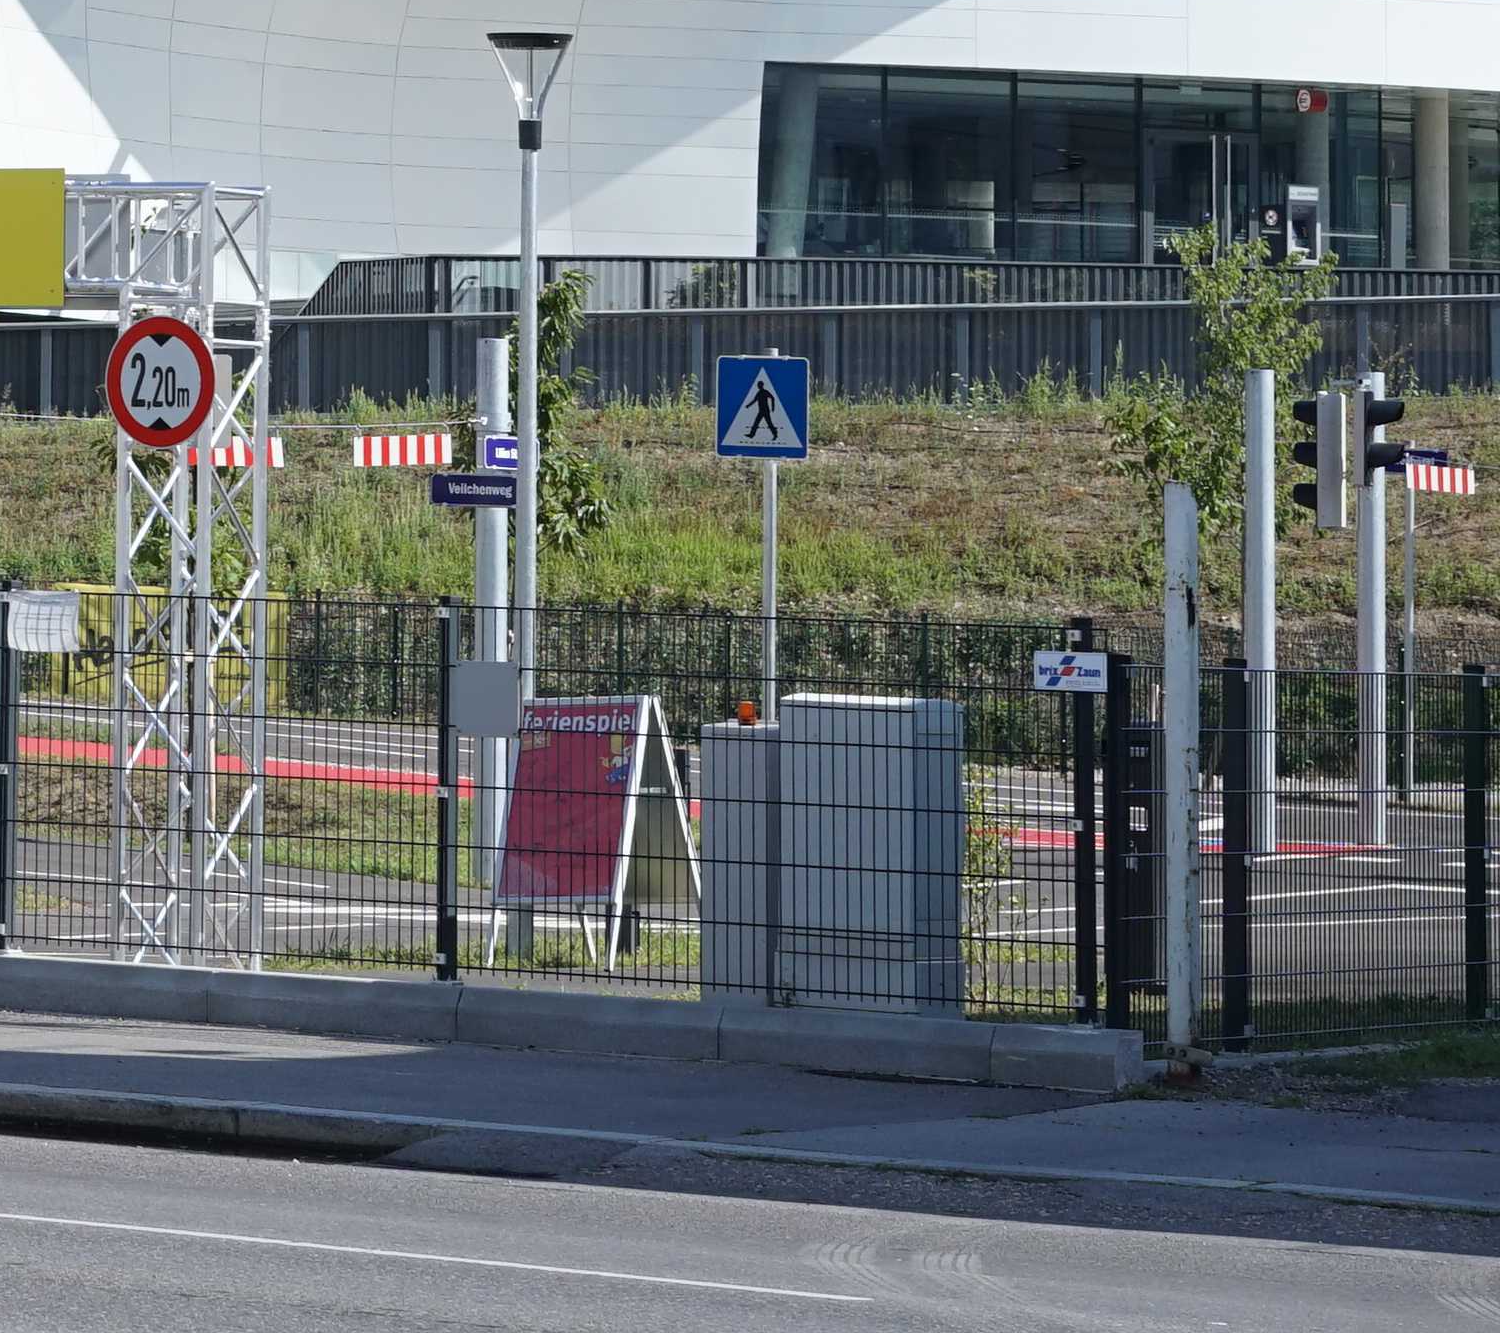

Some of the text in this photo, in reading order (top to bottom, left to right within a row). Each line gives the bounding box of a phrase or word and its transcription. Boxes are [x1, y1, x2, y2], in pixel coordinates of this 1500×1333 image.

[448, 482, 513, 499] Veilchenweg
[1039, 664, 1102, 678] brix Zaun
[523, 709, 636, 737] ferienspiel
